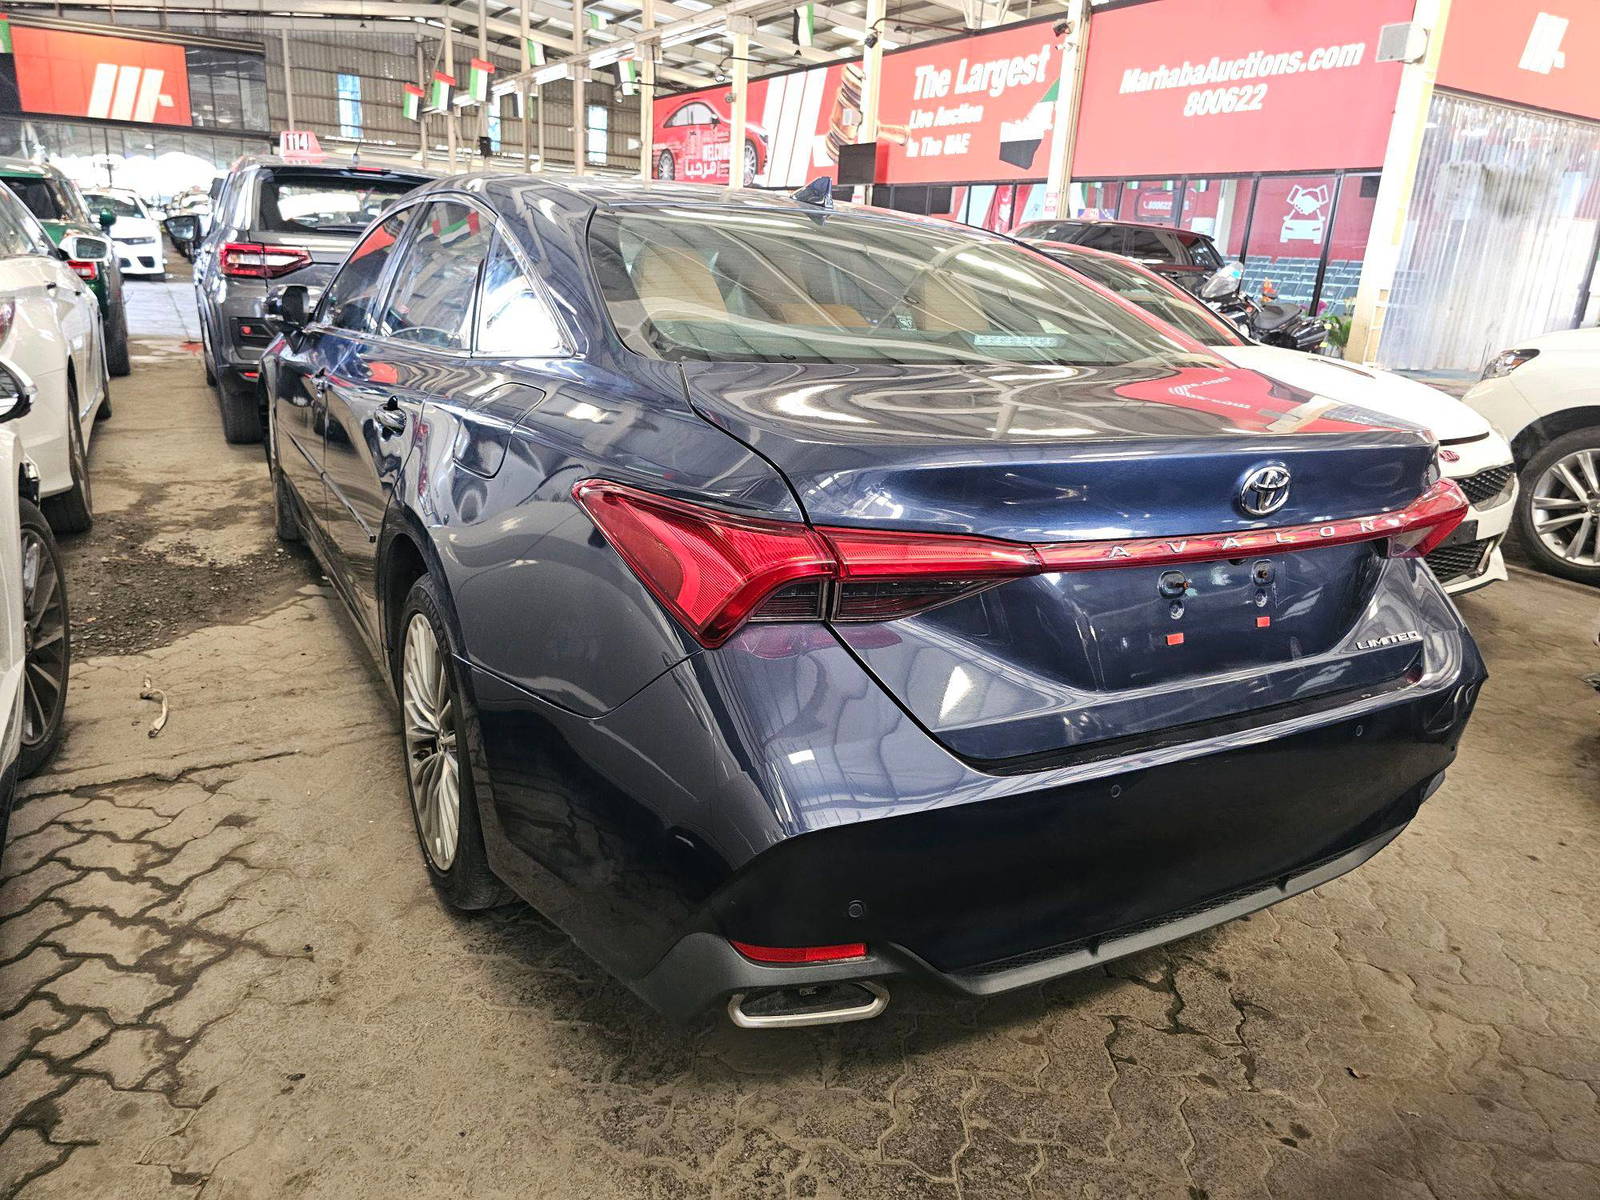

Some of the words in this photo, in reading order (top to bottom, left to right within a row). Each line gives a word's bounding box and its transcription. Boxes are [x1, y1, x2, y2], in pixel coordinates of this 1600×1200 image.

[913, 64, 951, 100] The
[954, 44, 1051, 98] Largest
[1119, 42, 1366, 94] MarhabaAuctions.com
[1183, 83, 1268, 117] 800622
[1107, 518, 1375, 559] AVALON
[1355, 630, 1418, 650] LIMITED
